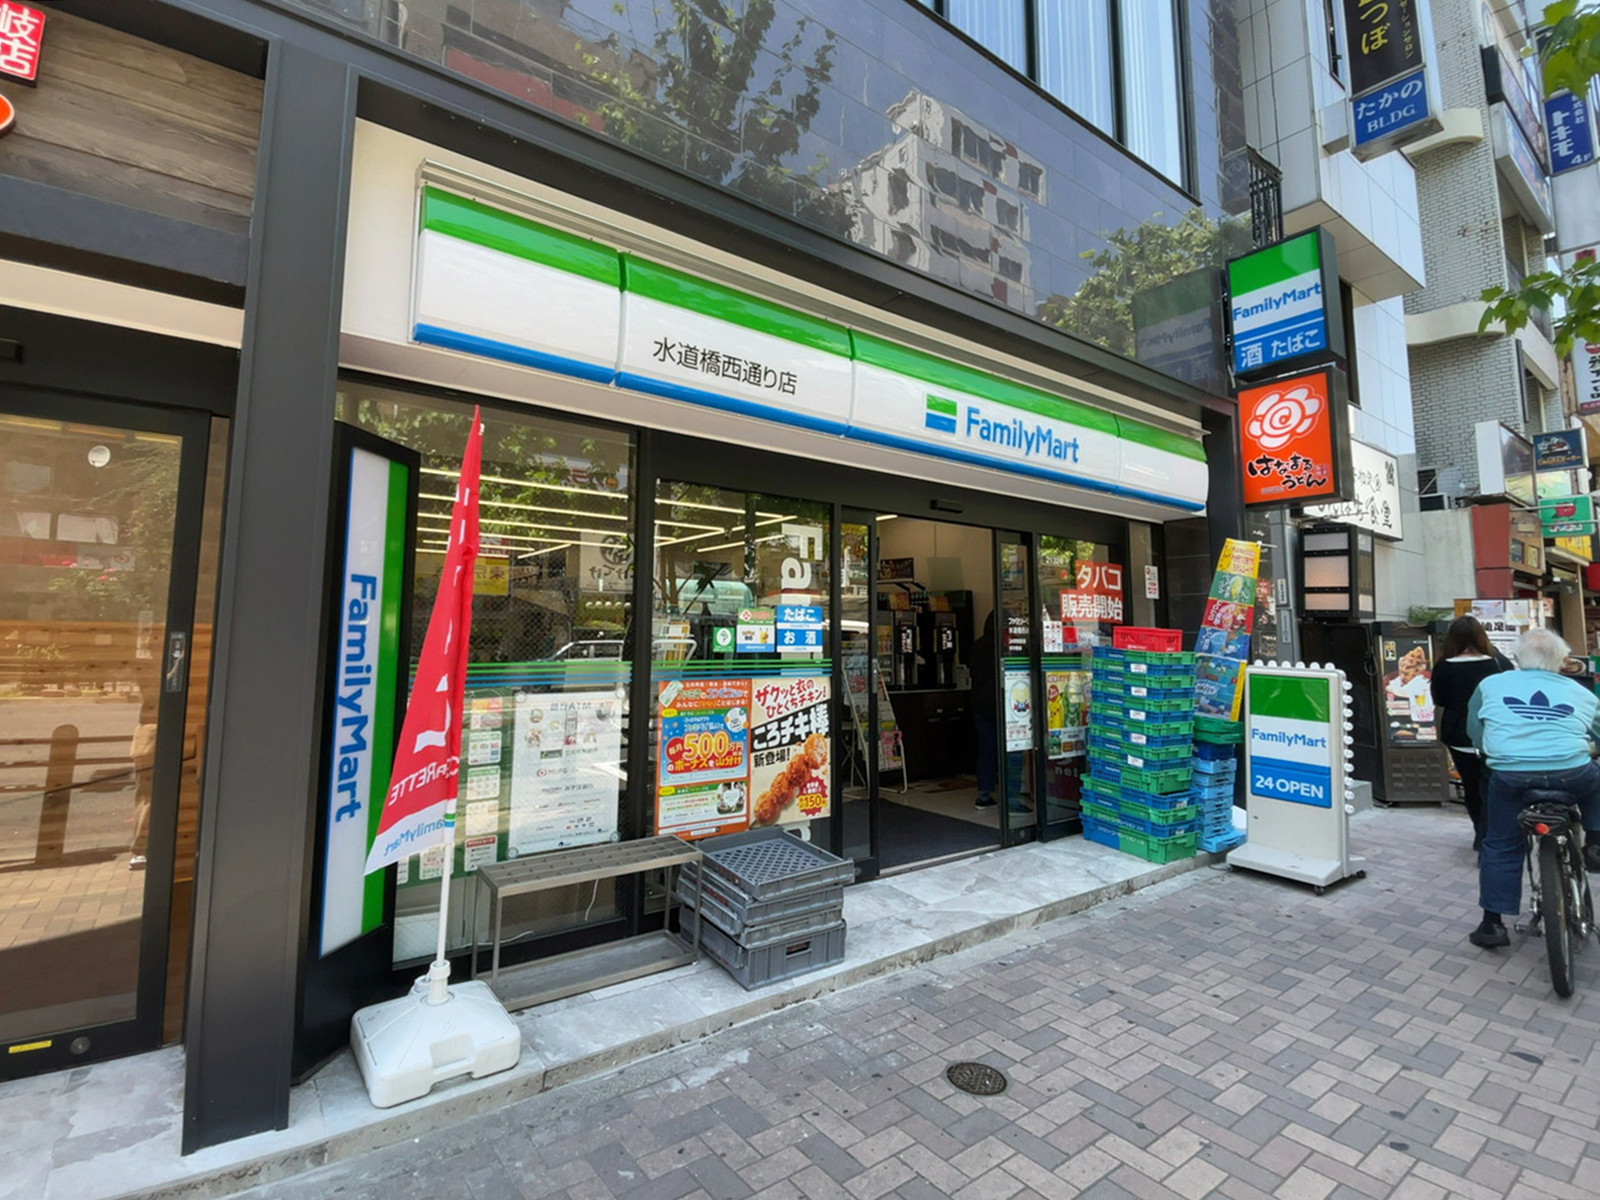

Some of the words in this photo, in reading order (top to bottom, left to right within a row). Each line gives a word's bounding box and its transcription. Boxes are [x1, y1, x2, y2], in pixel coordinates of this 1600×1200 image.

[1357, 80, 1423, 120] たかの
[1367, 104, 1416, 134] BLDG
[1232, 282, 1321, 321] FamilyMart
[1241, 342, 1262, 368] 酒
[1271, 328, 1321, 358] たばこ
[653, 337, 798, 396] 水道橋西通り店
[966, 406, 1080, 463] FamilyMart
[1248, 453, 1314, 477] はなまる
[1282, 472, 1327, 490] うどん
[1077, 564, 1122, 590] タバコ
[784, 608, 817, 622] たばこ
[1061, 593, 1123, 621] 販売開始
[334, 573, 378, 823] FamilyMart
[753, 703, 830, 750] ころチキ棒
[1251, 728, 1327, 748] FamilyMart
[754, 747, 791, 768] 新登場!
[1255, 774, 1274, 790] 24
[1275, 778, 1324, 799] OPEN
